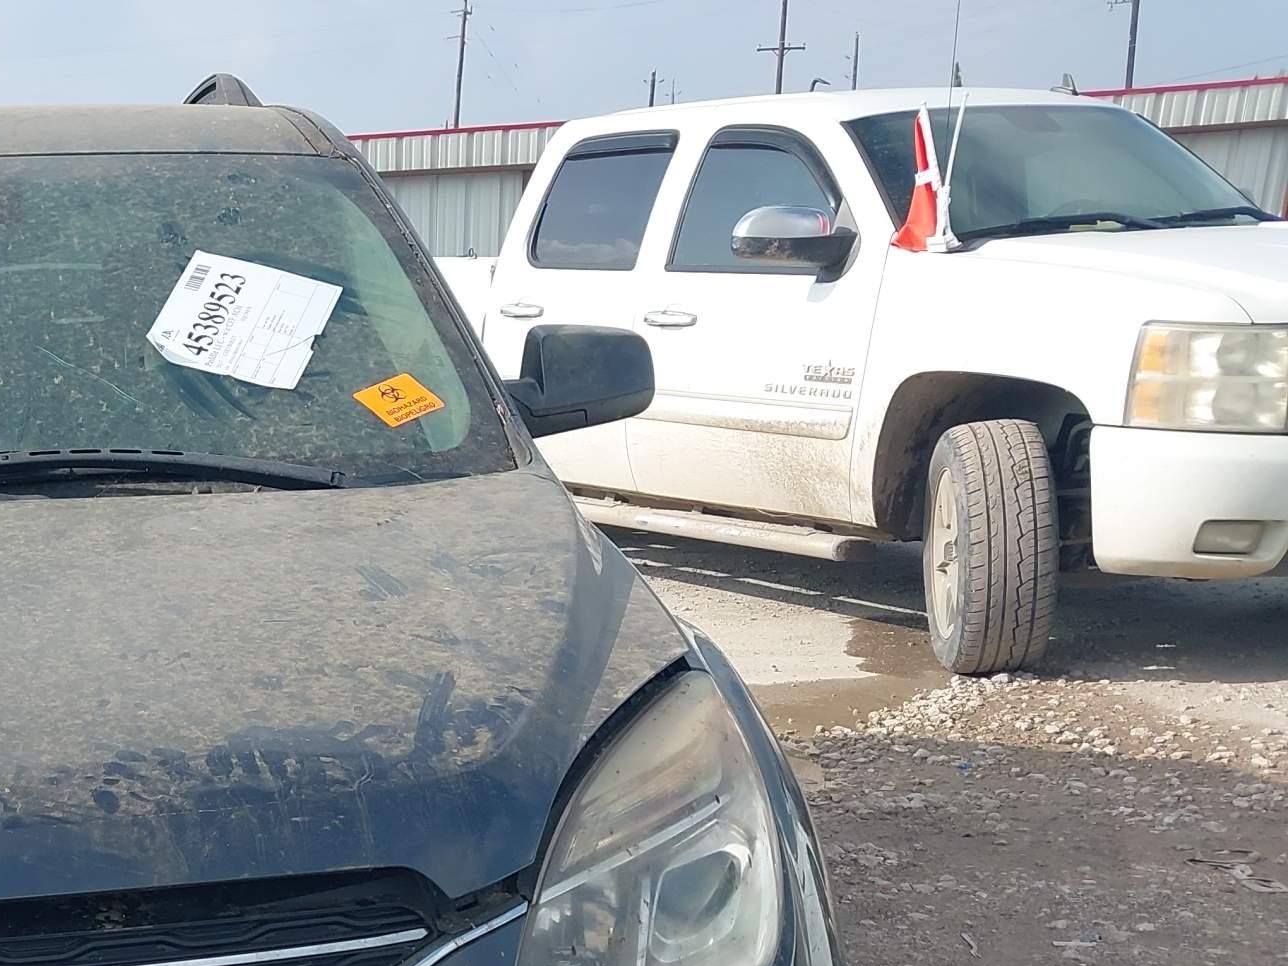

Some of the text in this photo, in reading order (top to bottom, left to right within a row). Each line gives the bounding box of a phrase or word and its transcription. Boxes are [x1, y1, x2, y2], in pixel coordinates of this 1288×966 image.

[183, 273, 246, 356] 45389523
[764, 383, 852, 400] SILVERADO
[386, 396, 428, 416] BIOHAZARD
